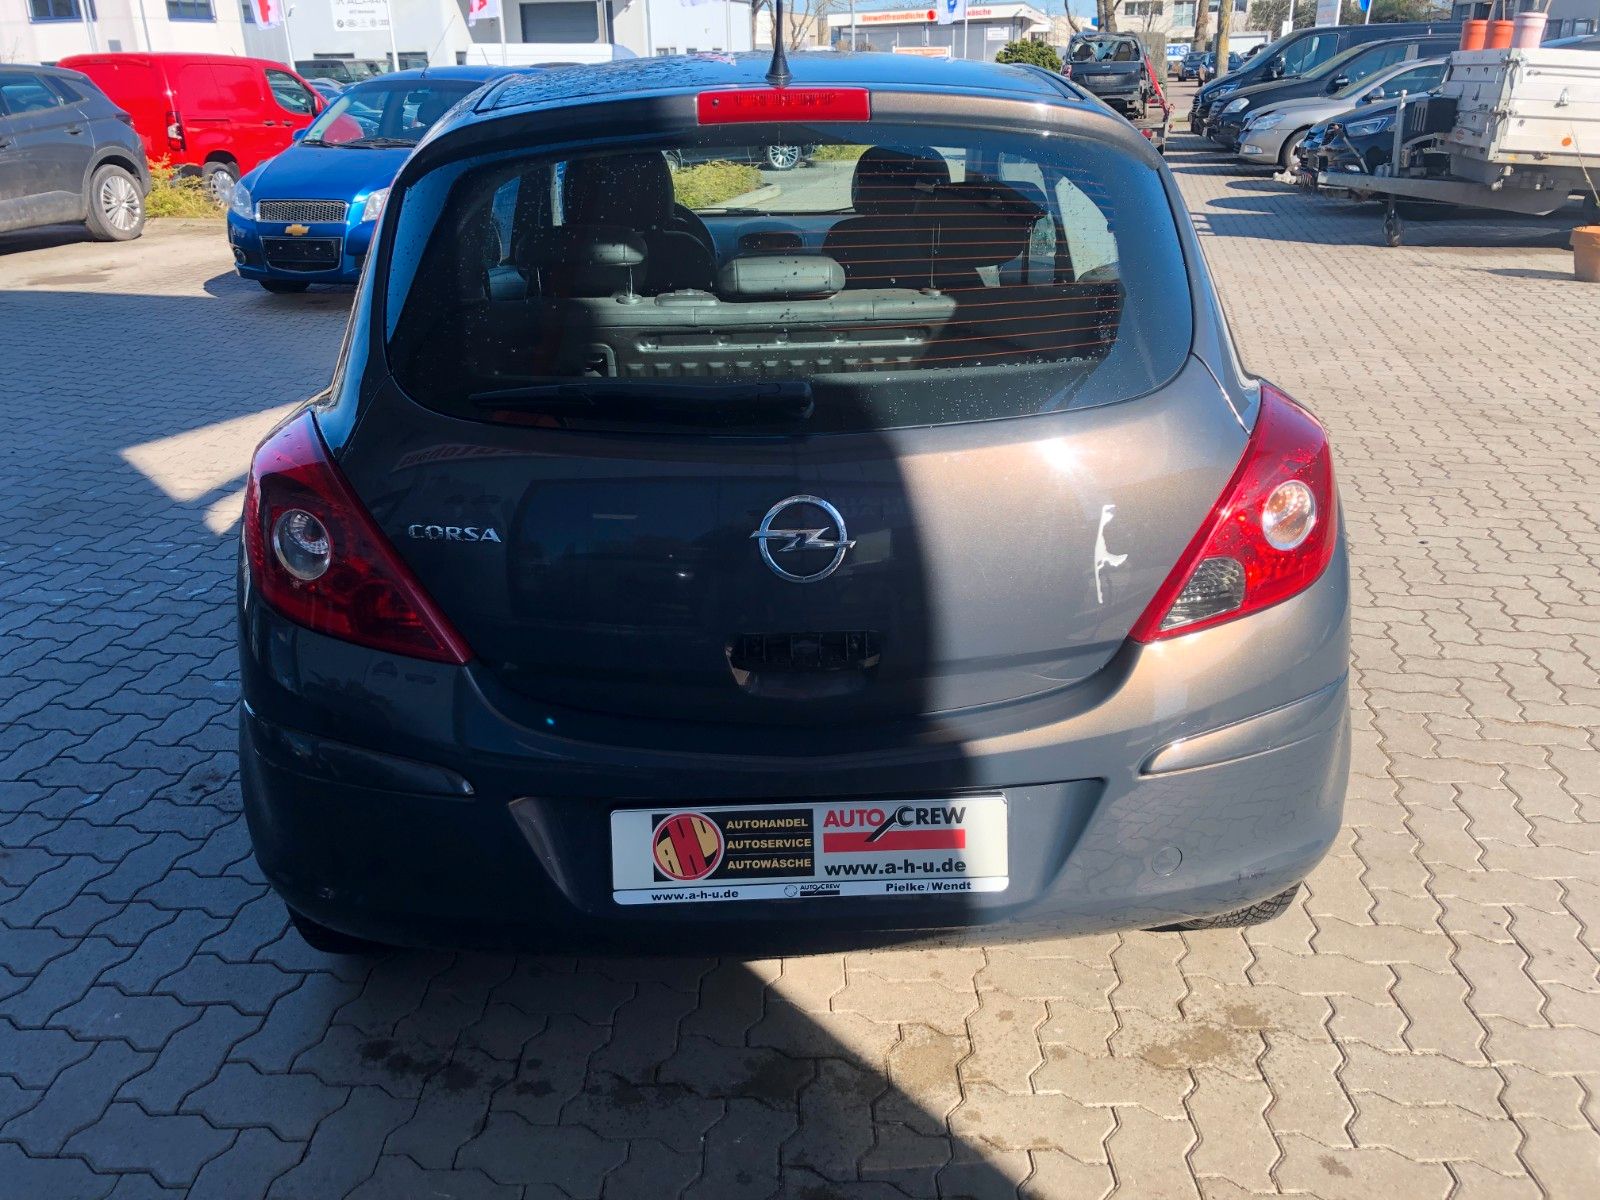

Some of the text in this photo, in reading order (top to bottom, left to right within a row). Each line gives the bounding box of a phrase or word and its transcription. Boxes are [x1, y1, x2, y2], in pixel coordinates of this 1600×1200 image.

[408, 524, 502, 543] CORSA
[726, 818, 808, 829] AUTOHANDEL
[727, 838, 812, 850] AUTOSERVICE
[728, 858, 812, 870] AUTOWÄSCHE
[824, 858, 967, 876] www.a-h-u.de
[651, 889, 739, 901] www.a-h-u.de
